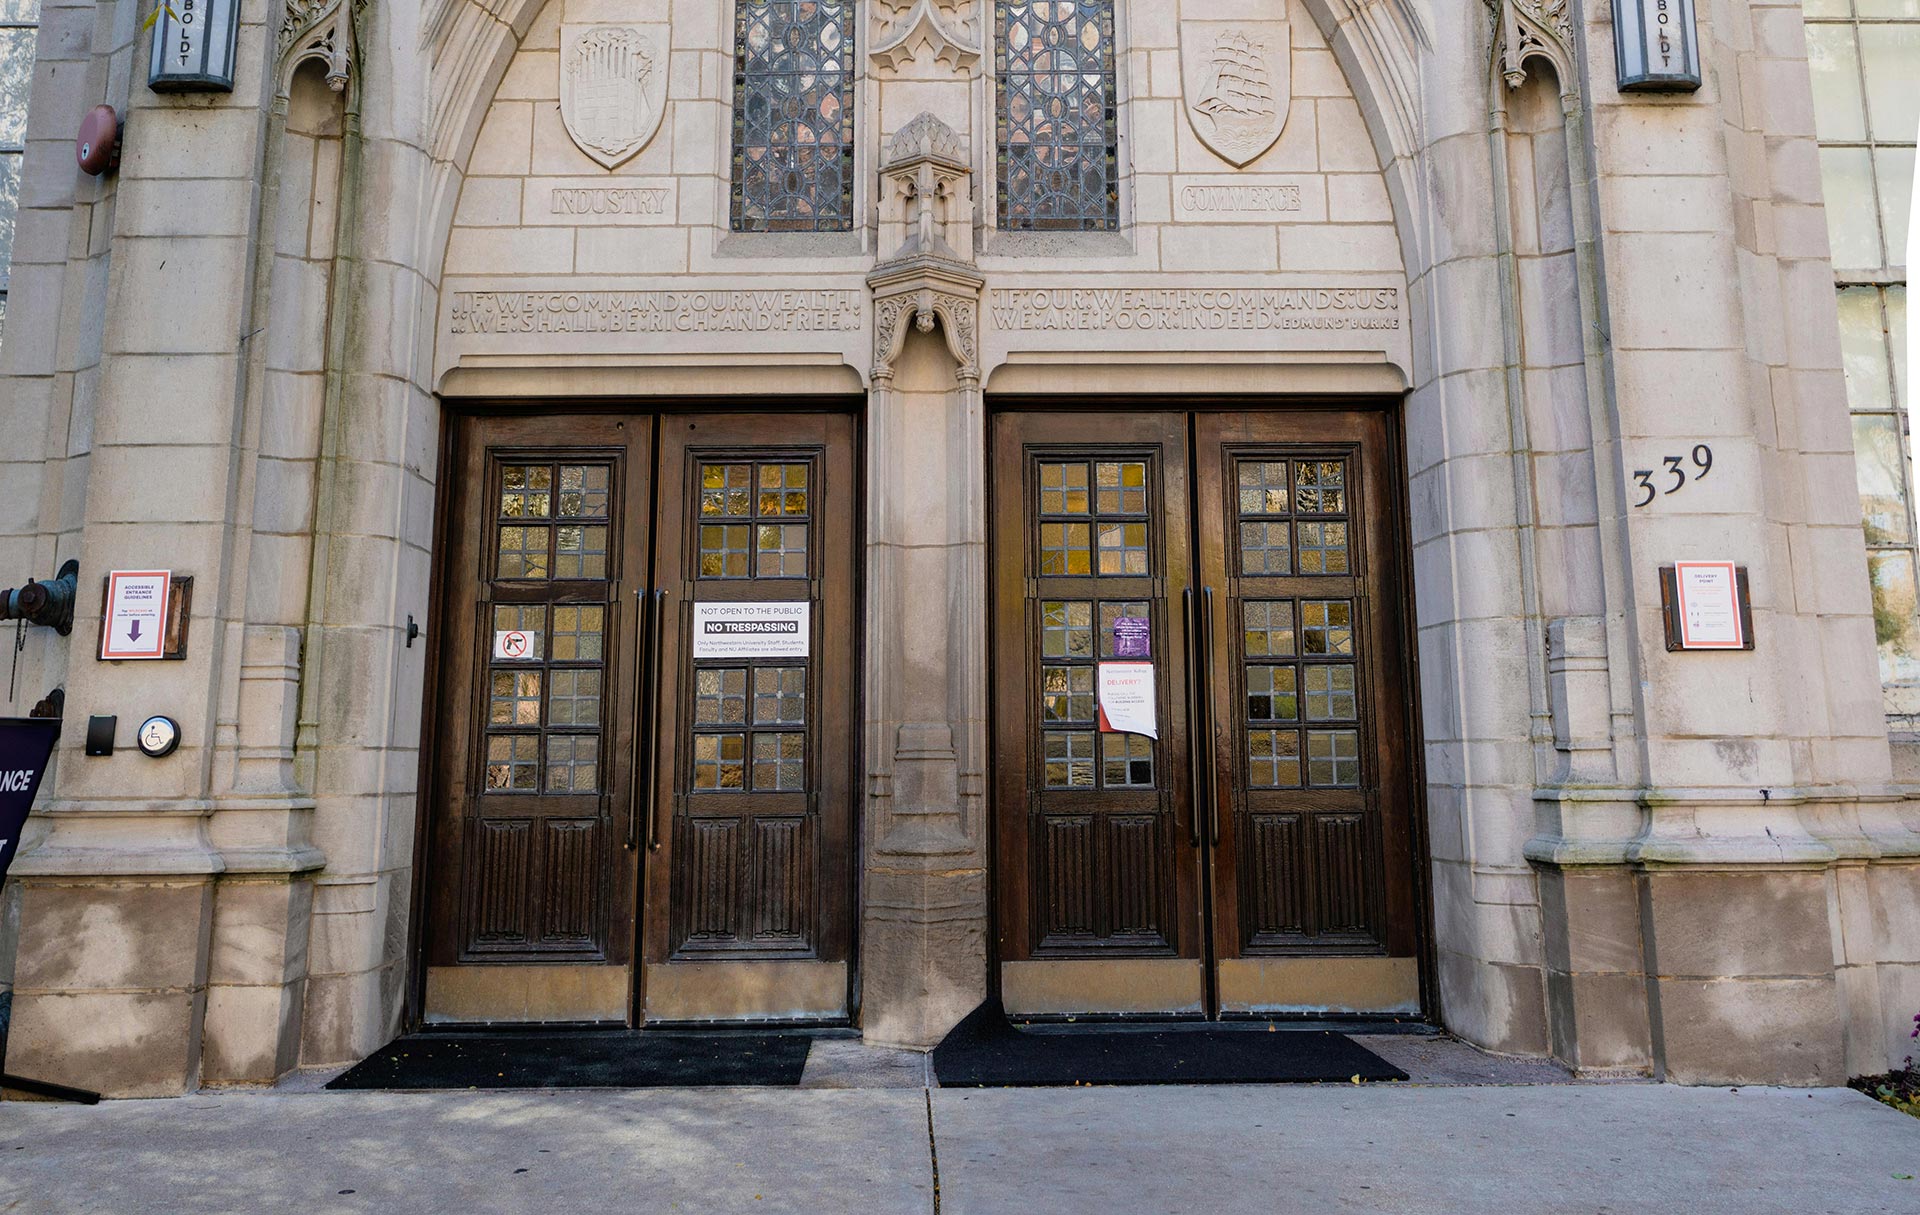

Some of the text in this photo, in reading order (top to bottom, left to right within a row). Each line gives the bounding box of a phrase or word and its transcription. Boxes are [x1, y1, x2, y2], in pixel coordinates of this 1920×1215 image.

[551, 188, 670, 214] INDUSTRY
[1181, 185, 1300, 211] COMMERCE
[545, 292, 680, 313] COMMAND
[690, 291, 745, 312] OUR
[751, 290, 851, 312] WEALTH
[1031, 289, 1085, 310] OUR
[1092, 289, 1191, 310] WEALTH
[1199, 289, 1348, 310] COMMANDS
[519, 312, 597, 333] SHALL
[649, 312, 709, 332] RICH
[719, 311, 773, 331] AND
[782, 311, 841, 331] FREE
[1043, 309, 1090, 330] ARE
[1101, 310, 1172, 330] POOR
[1181, 310, 1274, 330] INDEED
[1350, 318, 1400, 329] BURKE
[1633, 444, 1713, 508] 339
[744, 607, 755, 615] TO
[757, 607, 772, 615] THE
[774, 607, 803, 615] PUBLIC
[706, 622, 797, 632] NO TRESPASSING
[0, 770, 34, 792] NCE
